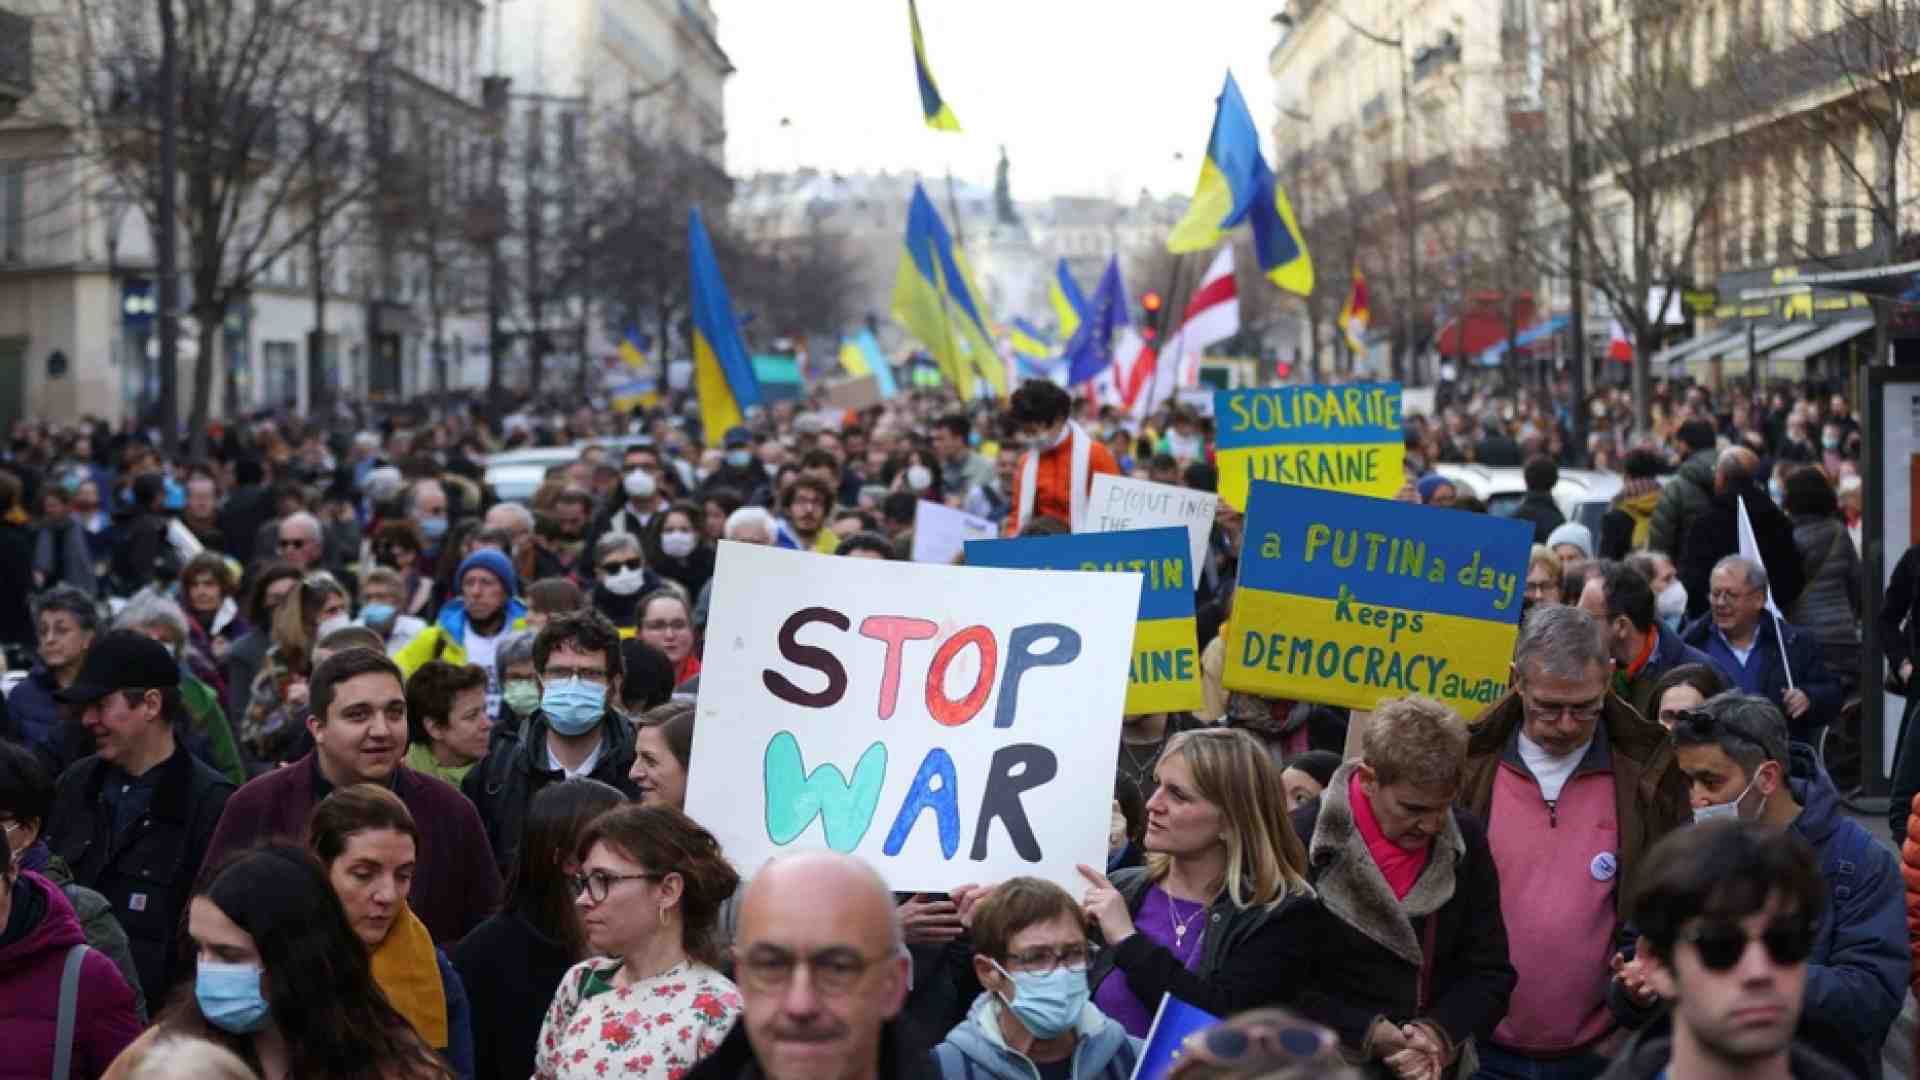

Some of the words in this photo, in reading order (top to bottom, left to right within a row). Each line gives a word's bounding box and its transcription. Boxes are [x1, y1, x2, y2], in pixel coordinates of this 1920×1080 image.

[1248, 447, 1381, 485] UKRAINE
[1260, 531, 1281, 559] a
[1304, 522, 1426, 577] PUTIN
[1427, 555, 1447, 583] a
[1457, 549, 1517, 610] day
[762, 606, 1083, 729] STOP
[1242, 631, 1447, 696] DEMOCRACY
[763, 730, 1059, 864] WAR
